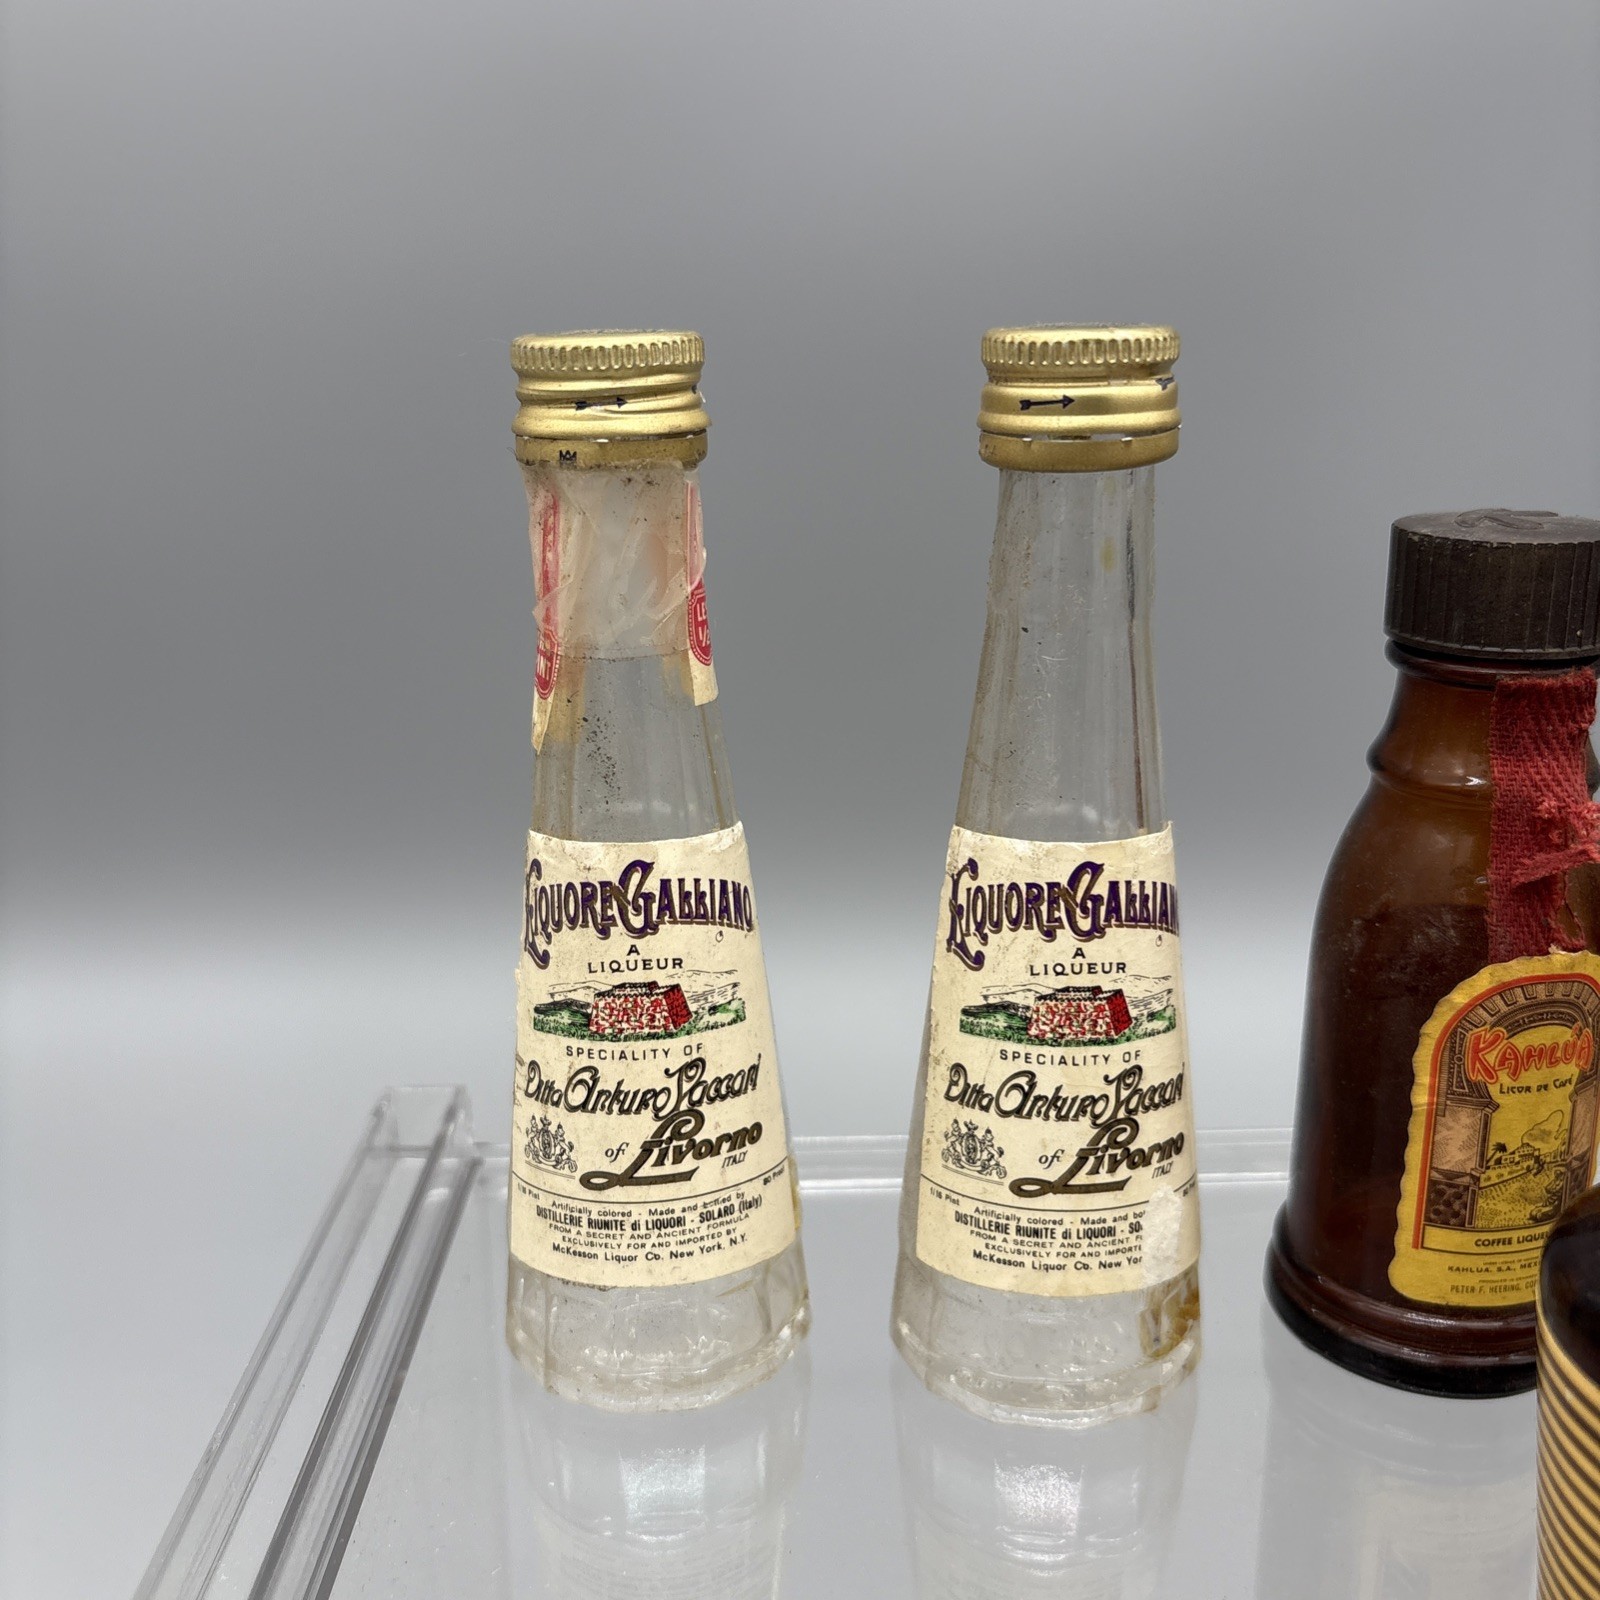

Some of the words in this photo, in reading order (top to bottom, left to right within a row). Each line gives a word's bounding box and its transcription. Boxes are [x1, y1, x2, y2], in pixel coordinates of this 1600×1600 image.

[524, 858, 618, 970] LIQUORE
[612, 859, 754, 940] GALLIANO
[946, 857, 1065, 971] LIQUORE
[626, 944, 640, 957] A
[1071, 947, 1086, 960] A
[588, 957, 684, 974] LIQUEUR
[1030, 962, 1127, 977] LIQUEUR
[566, 1045, 671, 1061] SPECIALITY
[684, 1043, 703, 1057] OF
[1000, 1049, 1110, 1066] SPECIALITY
[1122, 1050, 1142, 1063] OF
[563, 1065, 672, 1116] Arturo
[994, 1069, 1110, 1122] Arturo
[579, 1109, 763, 1191] Livorno
[605, 1142, 629, 1162] of
[721, 1151, 748, 1169] ITALY
[1008, 1117, 1185, 1198] Livorno
[1038, 1149, 1064, 1169] of
[1151, 1161, 1174, 1179] ITALY
[536, 1205, 583, 1228] DISTILLERIE
[587, 1217, 626, 1231] RIUNITE
[631, 1218, 641, 1231] di
[645, 1215, 686, 1232] LIQUORI
[699, 1203, 735, 1224] SOLARO
[738, 1194, 762, 1214] (Italy)
[551, 1200, 592, 1217] Artificially
[597, 1209, 632, 1218] colored
[648, 1207, 675, 1217] Made
[681, 1203, 698, 1213] and
[736, 1191, 745, 1202] by
[955, 1210, 1010, 1235] DISTILLERIE
[1015, 1225, 1056, 1240] RIUNITE
[1061, 1228, 1072, 1240] di
[1076, 1225, 1116, 1240] LIQUORI
[974, 1206, 1021, 1224] Artificially
[1027, 1217, 1063, 1226] colored
[1080, 1217, 1107, 1225] Made
[1112, 1213, 1128, 1223] and
[549, 1223, 572, 1234] FROM
[576, 1229, 583, 1237] A
[586, 1231, 625, 1241] SECRET
[656, 1226, 701, 1239] ANCIENT
[707, 1213, 750, 1231] FORMULA
[552, 1242, 599, 1260] McKesson
[604, 1252, 638, 1264] Liquor
[645, 1251, 664, 1262] Co.
[669, 1249, 695, 1260] New
[729, 1233, 748, 1247] N.Y.
[562, 1235, 622, 1250] EXCLUSIVELY
[627, 1242, 647, 1250] FOR
[651, 1241, 671, 1249] AND
[675, 1231, 723, 1246] IMPORTED
[726, 1227, 738, 1236] BY
[970, 1229, 996, 1241] FROM
[1001, 1236, 1009, 1244] A
[1013, 1238, 1054, 1248] SECRET
[1059, 1240, 1082, 1248] AND
[1087, 1236, 1130, 1249] ANCIENT
[1474, 1236, 1513, 1248] COFFEE
[1516, 1230, 1549, 1245] LIQUE
[985, 1242, 1052, 1258] EXCLUSIVELY
[1056, 1250, 1076, 1259] FOR
[1080, 1250, 1101, 1258] AND
[973, 1249, 1025, 1268] McKesson
[1031, 1260, 1067, 1273] Liquor
[1074, 1260, 1092, 1271] Co.
[1098, 1259, 1122, 1270] New
[1519, 1260, 1540, 1270] MEX
[1450, 1284, 1475, 1294] PETER
[1478, 1285, 1486, 1294] F.
